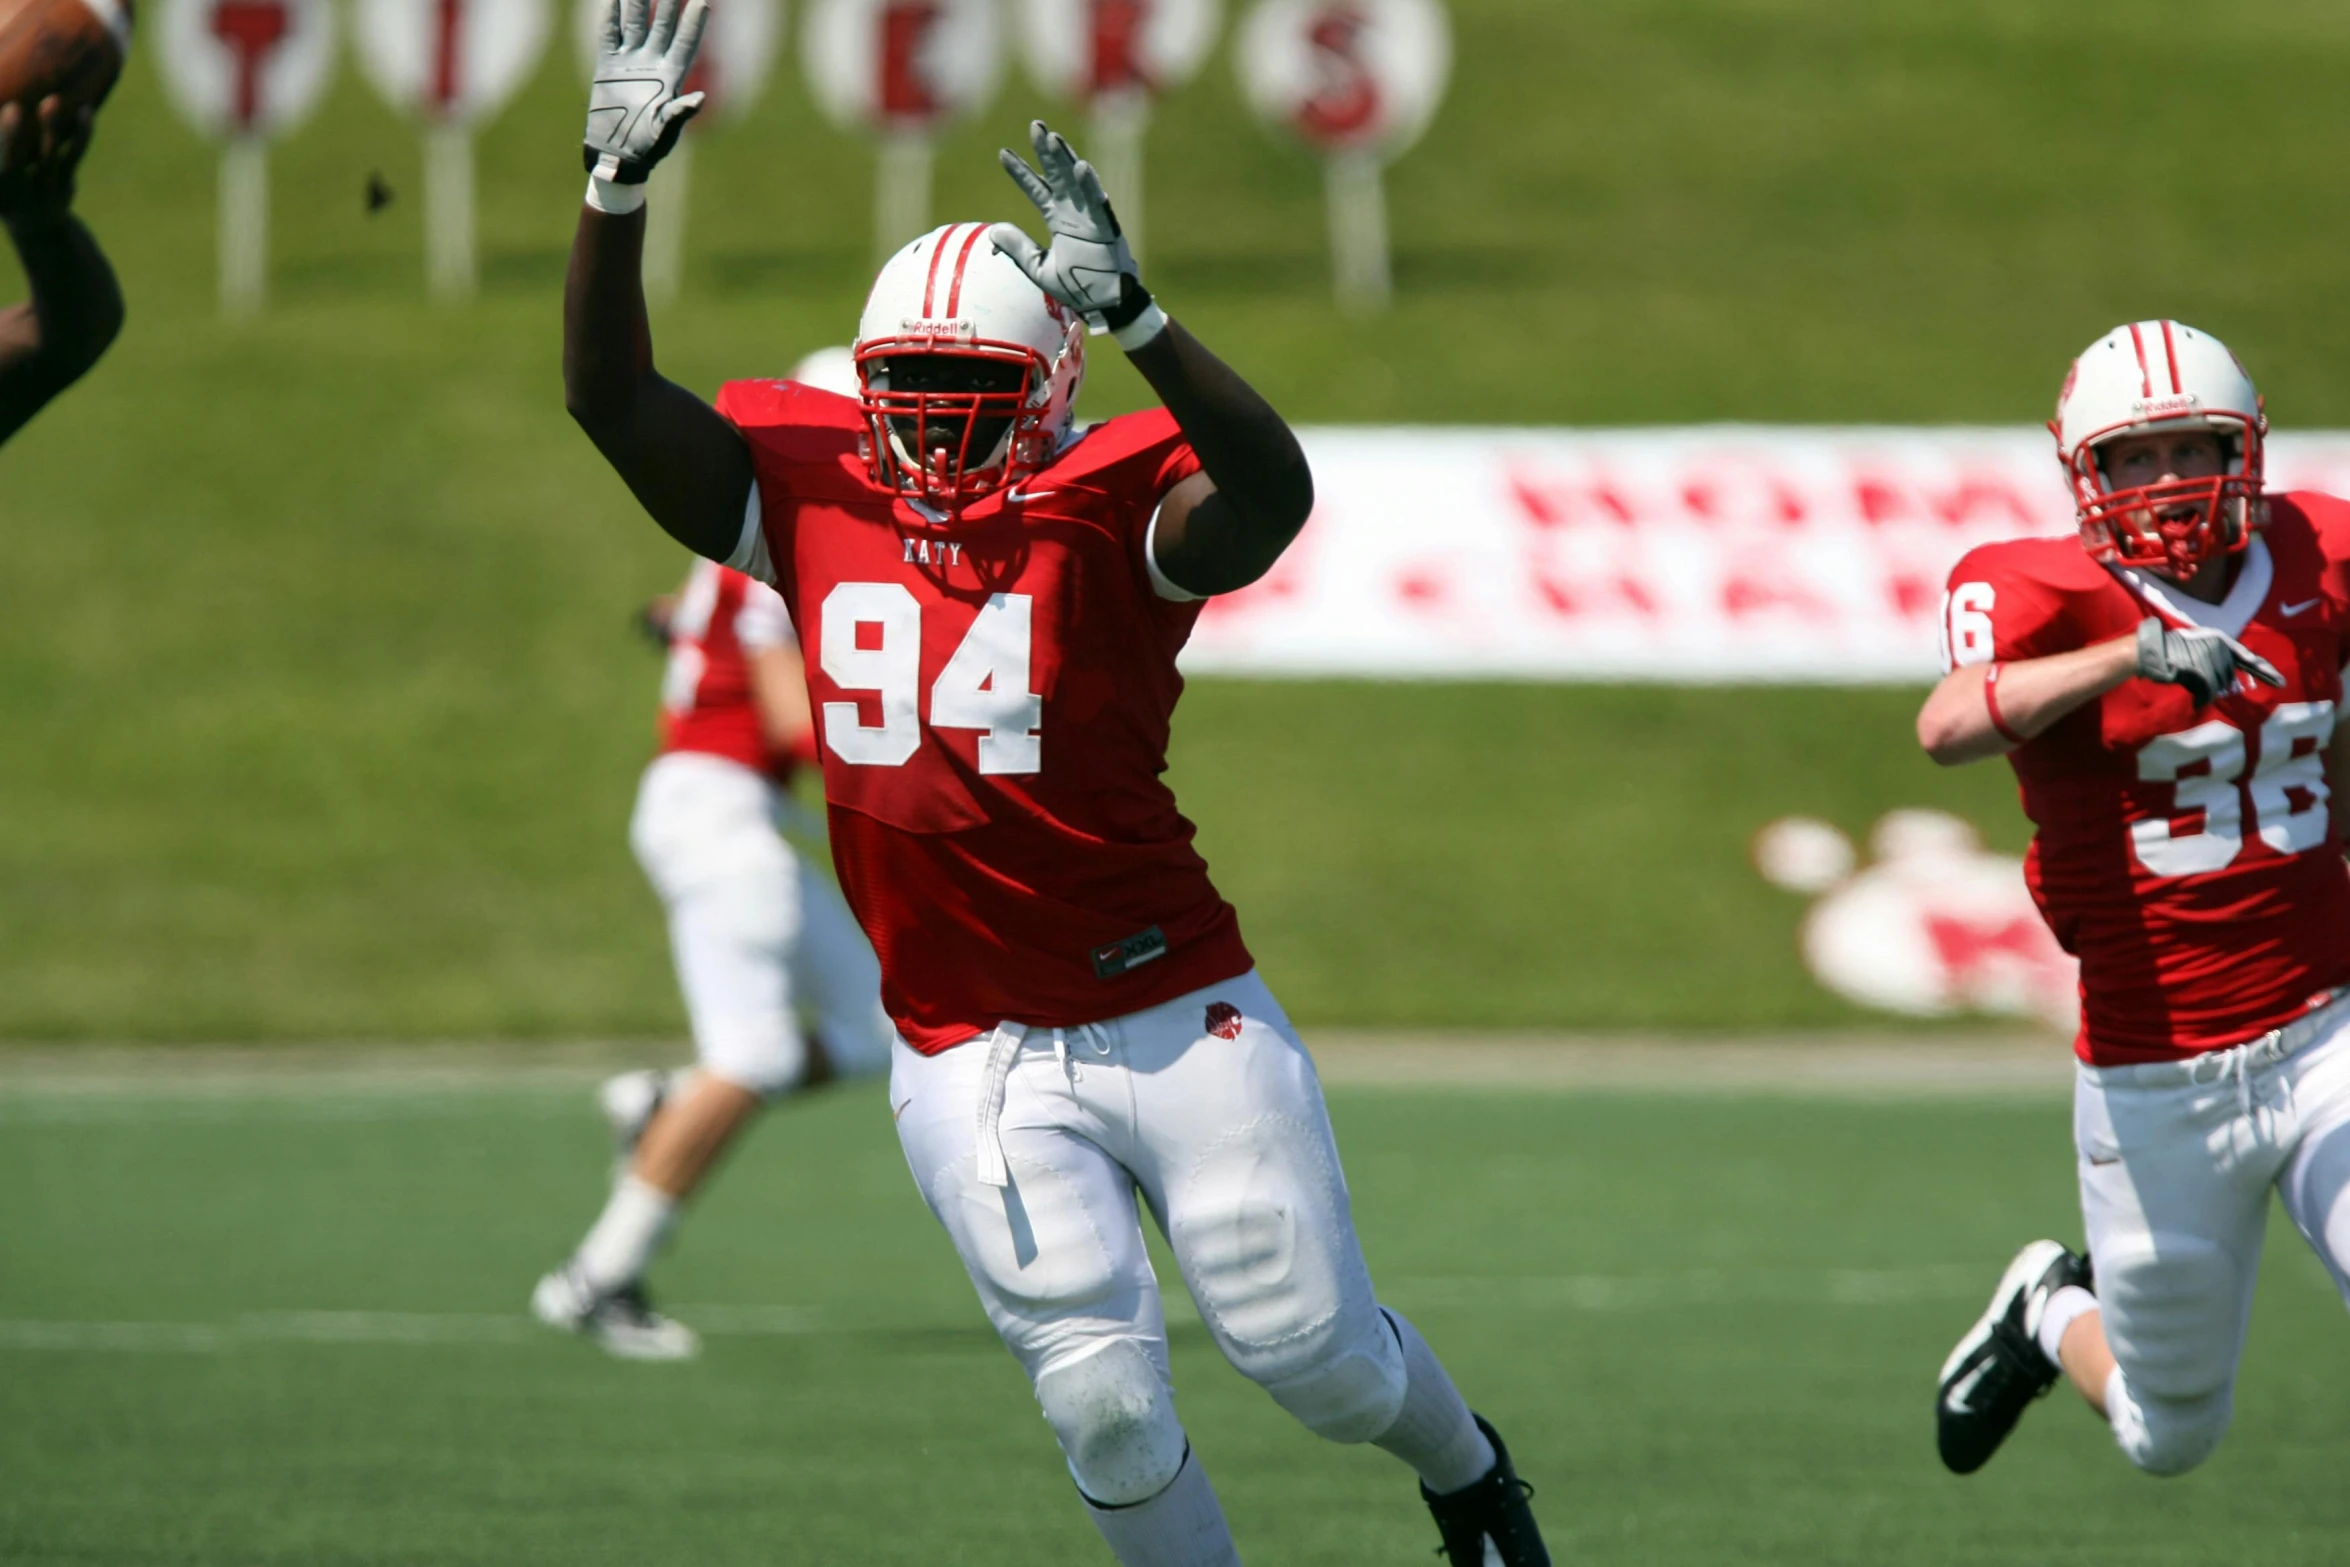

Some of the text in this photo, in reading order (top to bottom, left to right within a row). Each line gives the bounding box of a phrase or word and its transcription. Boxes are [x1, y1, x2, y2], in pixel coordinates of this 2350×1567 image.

[914, 321, 958, 335] Riddell
[903, 538, 962, 566] KATY
[1939, 581, 1996, 675] 6
[819, 581, 1043, 775] 94
[1124, 934, 1164, 957] XXL
